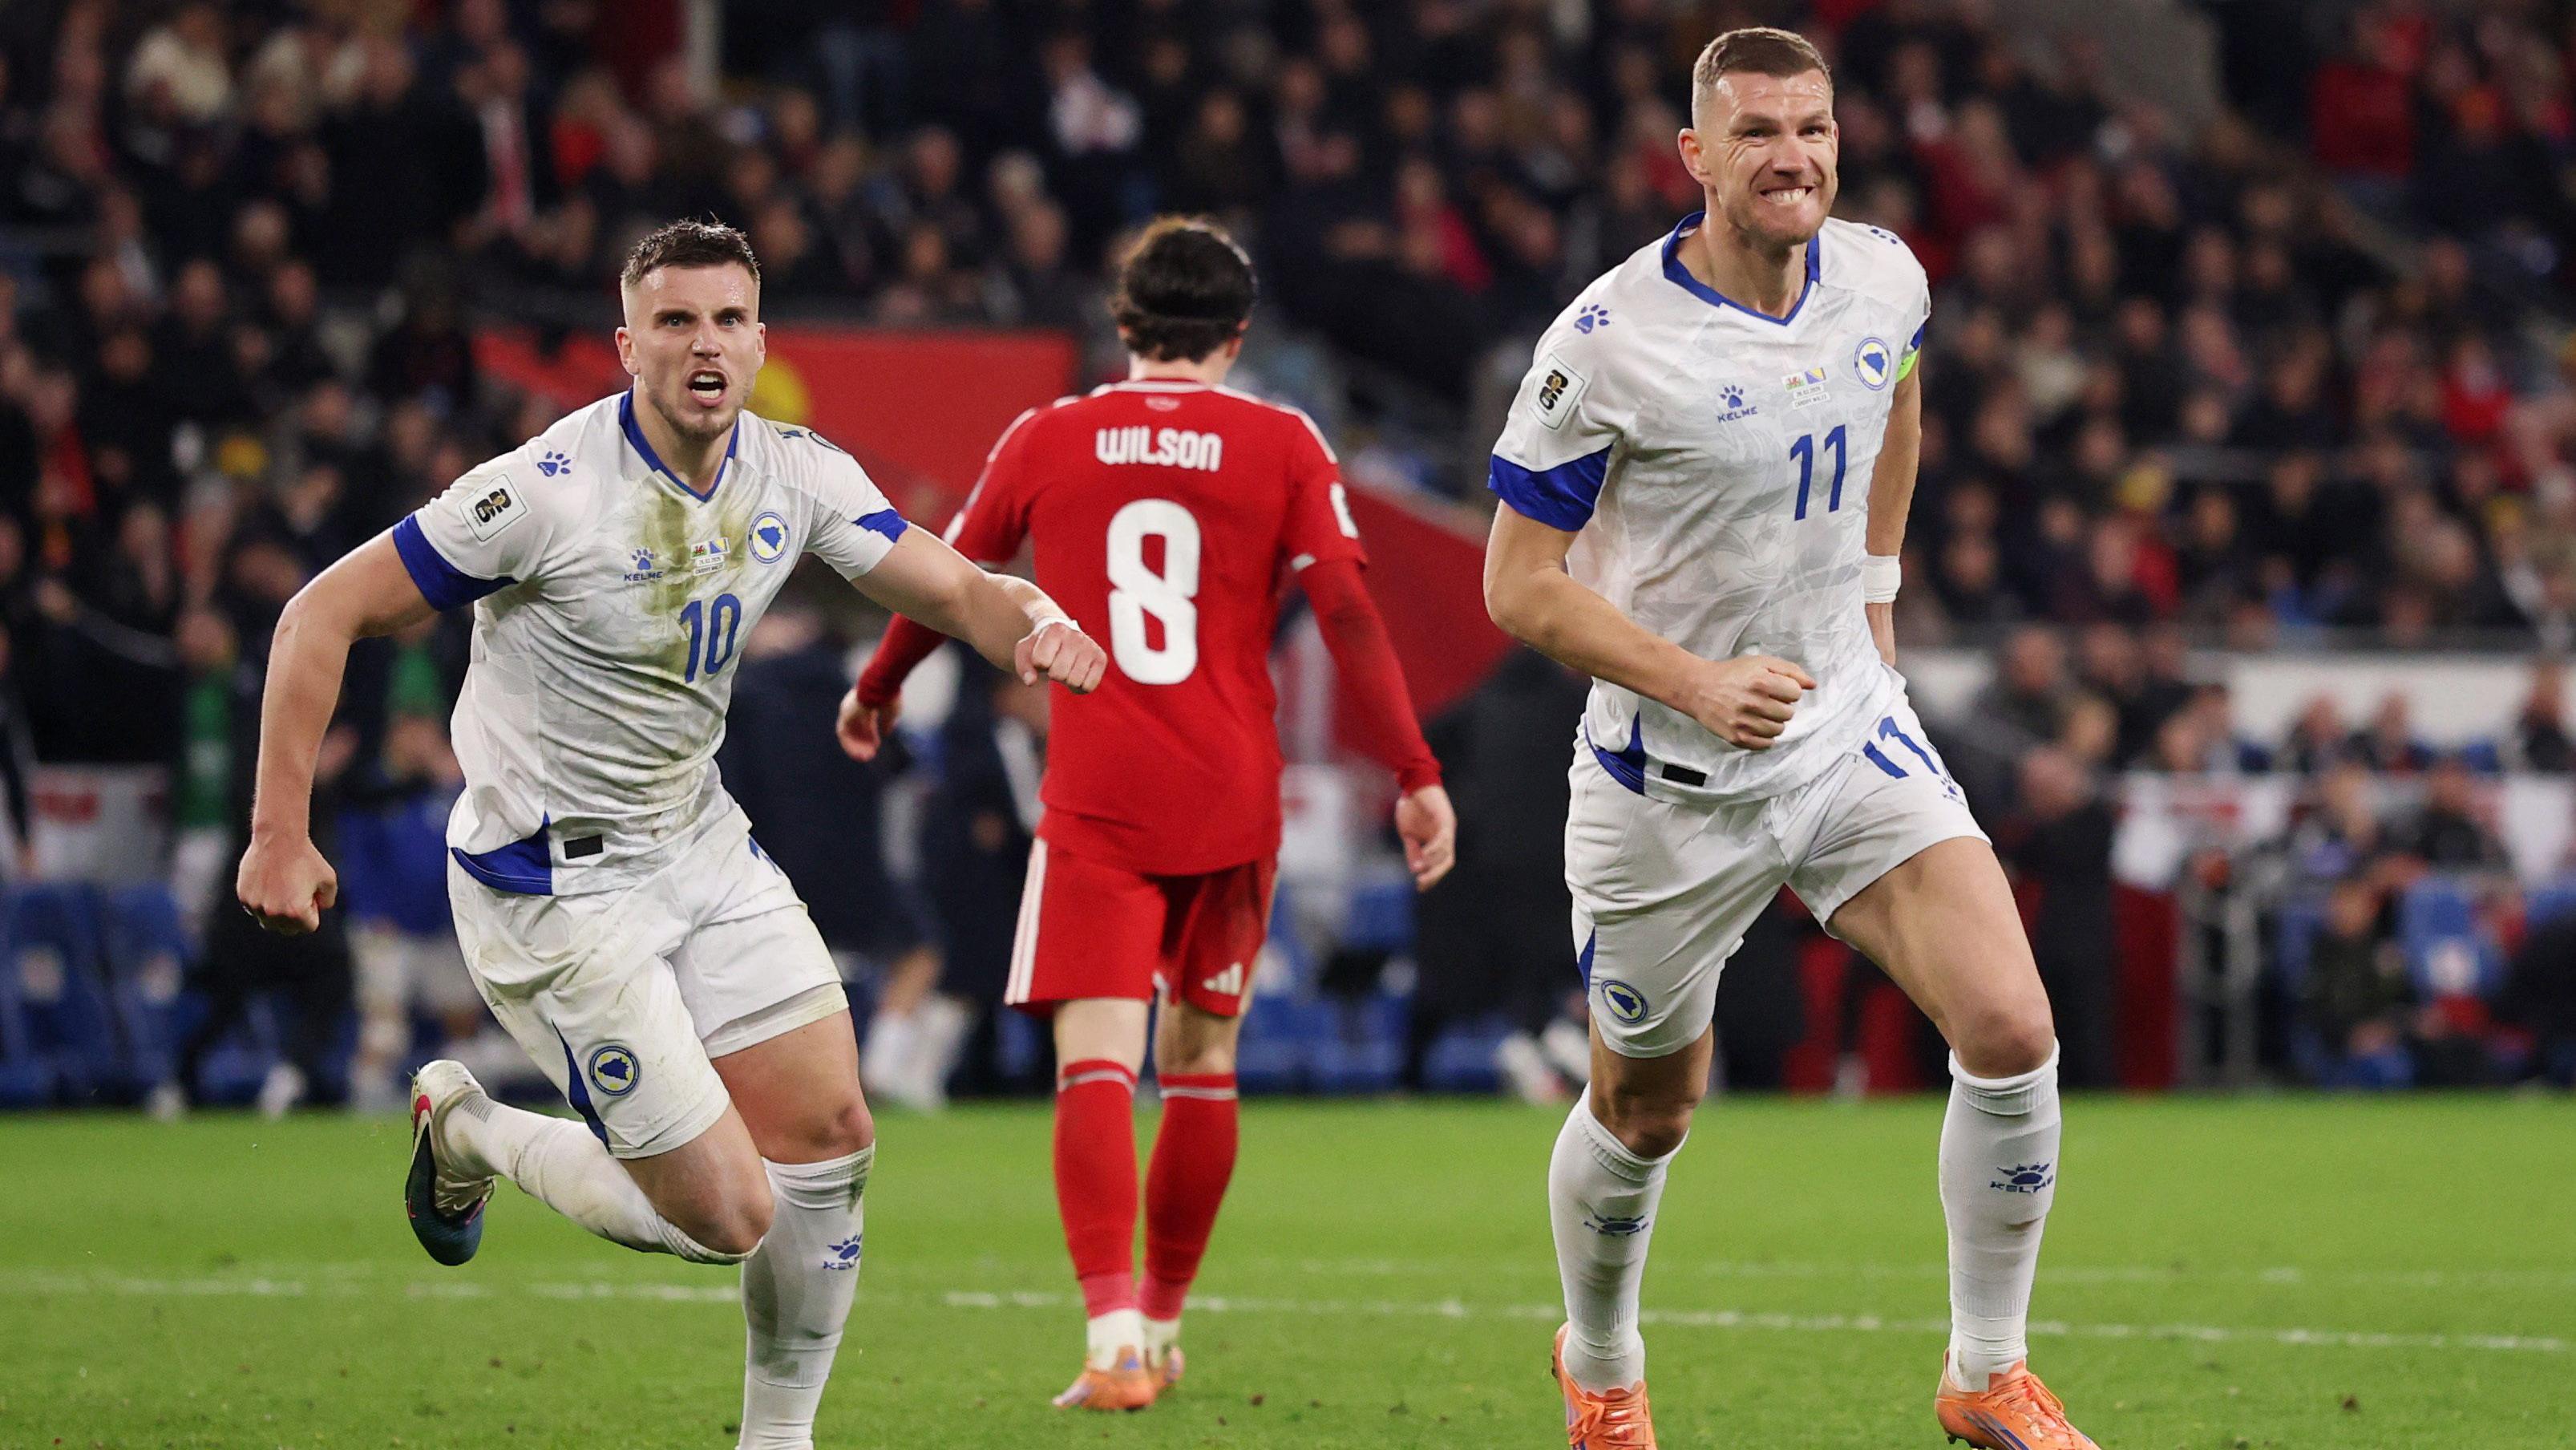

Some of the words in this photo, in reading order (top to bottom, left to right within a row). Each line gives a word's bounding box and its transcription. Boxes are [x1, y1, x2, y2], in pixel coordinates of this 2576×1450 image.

[1717, 406, 1758, 423] KELME
[1095, 425, 1223, 472] WILSON
[1789, 423, 1846, 521] 11
[624, 571, 664, 581] KELME
[1106, 497, 1201, 685] 8
[679, 593, 741, 683] 10
[1862, 716, 1940, 780] 11
[1990, 1175, 2054, 1193] KELME
